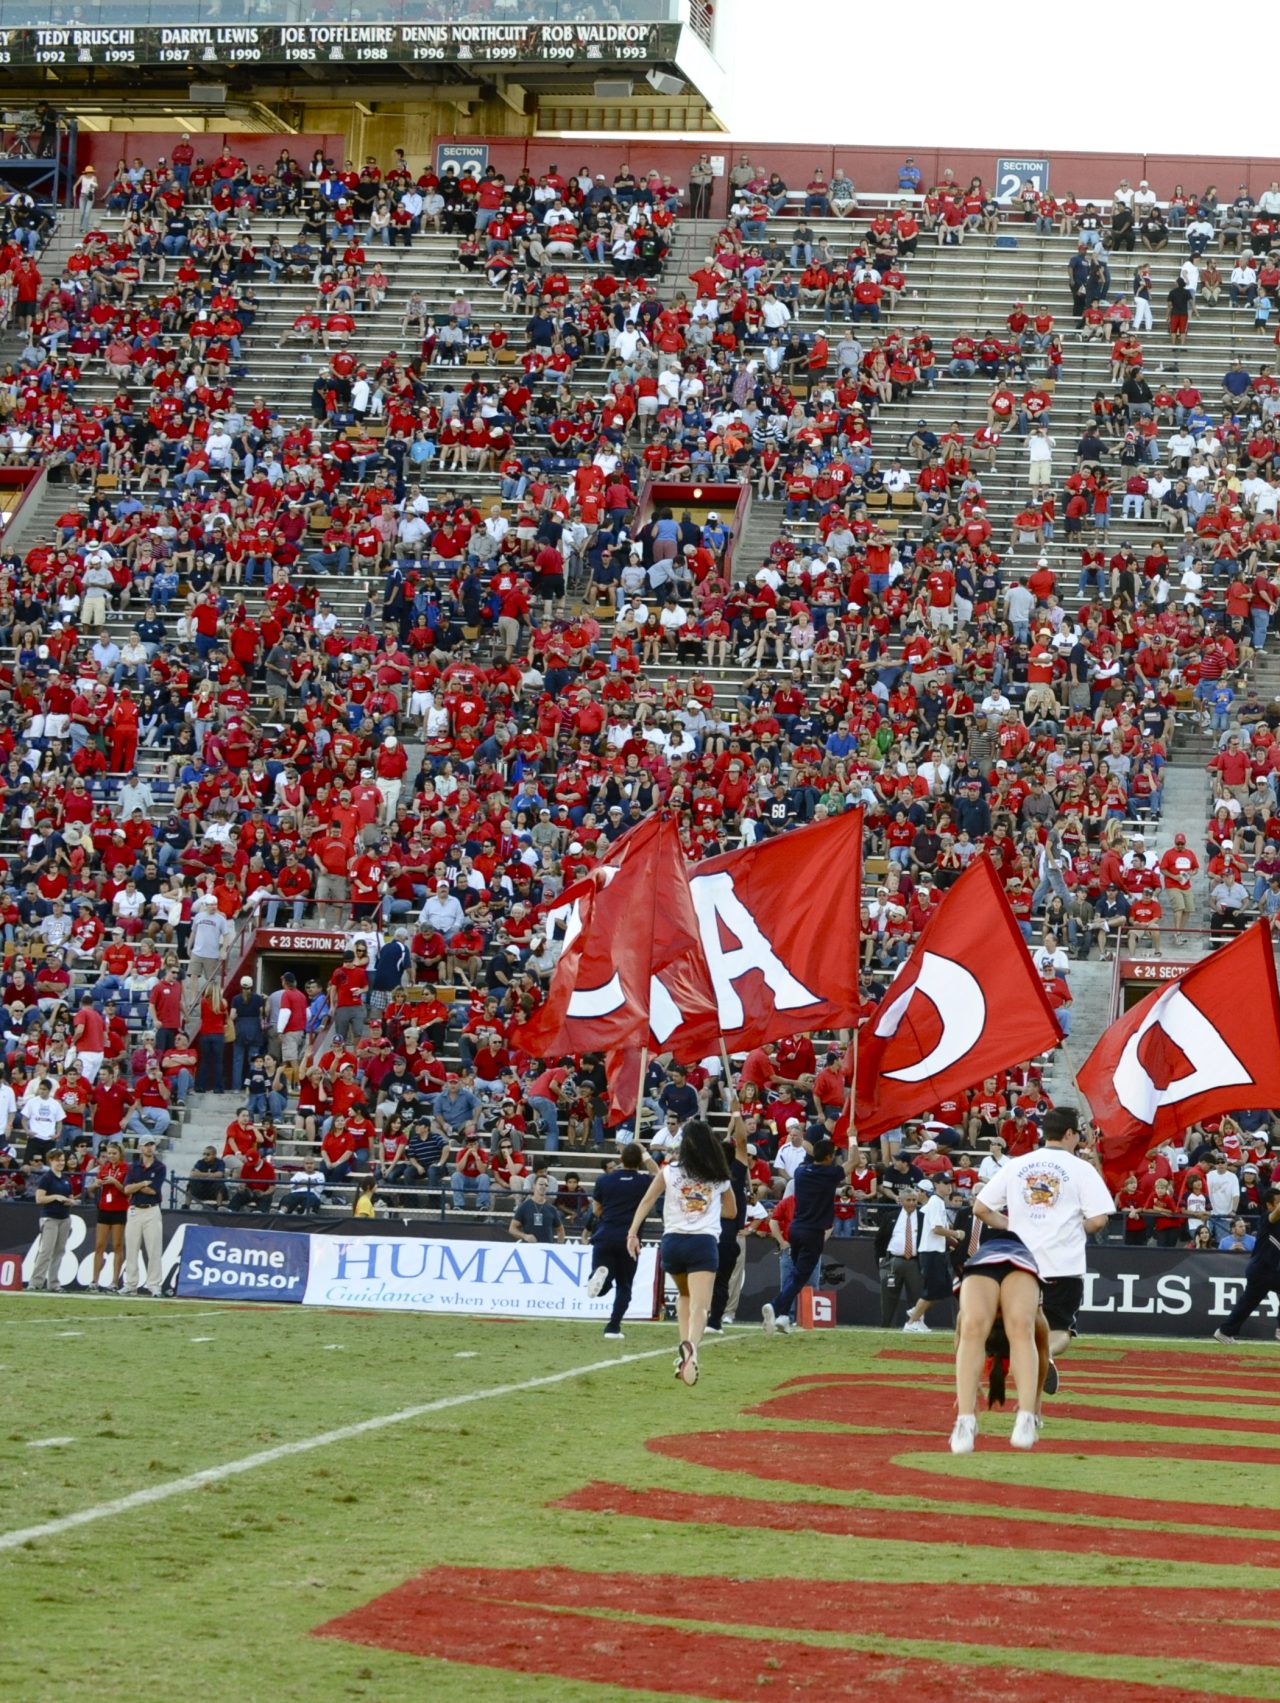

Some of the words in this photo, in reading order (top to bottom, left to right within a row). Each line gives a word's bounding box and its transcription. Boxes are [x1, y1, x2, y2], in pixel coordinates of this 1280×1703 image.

[37, 30, 70, 45] TEDY
[74, 29, 135, 45] BRUSCHI
[161, 28, 213, 44] DARRYL
[217, 27, 259, 43] LEWIS
[281, 27, 306, 46] JOE
[309, 27, 393, 43] TOFFLEMIRE
[402, 26, 448, 42] DENNIS
[452, 26, 528, 42] NORTHCUTT
[542, 26, 573, 41] ROB
[577, 25, 648, 41] WALDROP
[36, 51, 66, 62] 1992
[105, 50, 136, 62] 1995
[159, 49, 190, 61] 1987
[229, 49, 261, 60] 1990
[285, 49, 316, 60] 1985
[356, 48, 388, 60] 1988
[413, 47, 445, 59] 1996
[485, 47, 517, 59] 1999
[542, 47, 574, 59] 1990
[615, 47, 647, 59] 1993
[443, 147, 483, 156] SECTION
[1002, 161, 1043, 171] SECTION
[831, 470, 844, 481] 48
[771, 804, 786, 819] 68
[1135, 875, 1143, 885] 7
[280, 936, 291, 948] 23
[294, 937, 331, 949] SECTION
[334, 938, 345, 950] 24
[1145, 966, 1156, 978] 24
[1017, 1161, 1070, 1183] HOMECOMING
[207, 1240, 285, 1269] Game
[331, 1242, 589, 1288] HUMAN
[187, 1259, 300, 1290] Sponsor
[325, 1282, 434, 1305] Guidance
[440, 1292, 484, 1306] when
[490, 1298, 521, 1311] you
[526, 1296, 566, 1311] need
[572, 1298, 583, 1311] it
[1080, 1272, 1192, 1315] LLS
